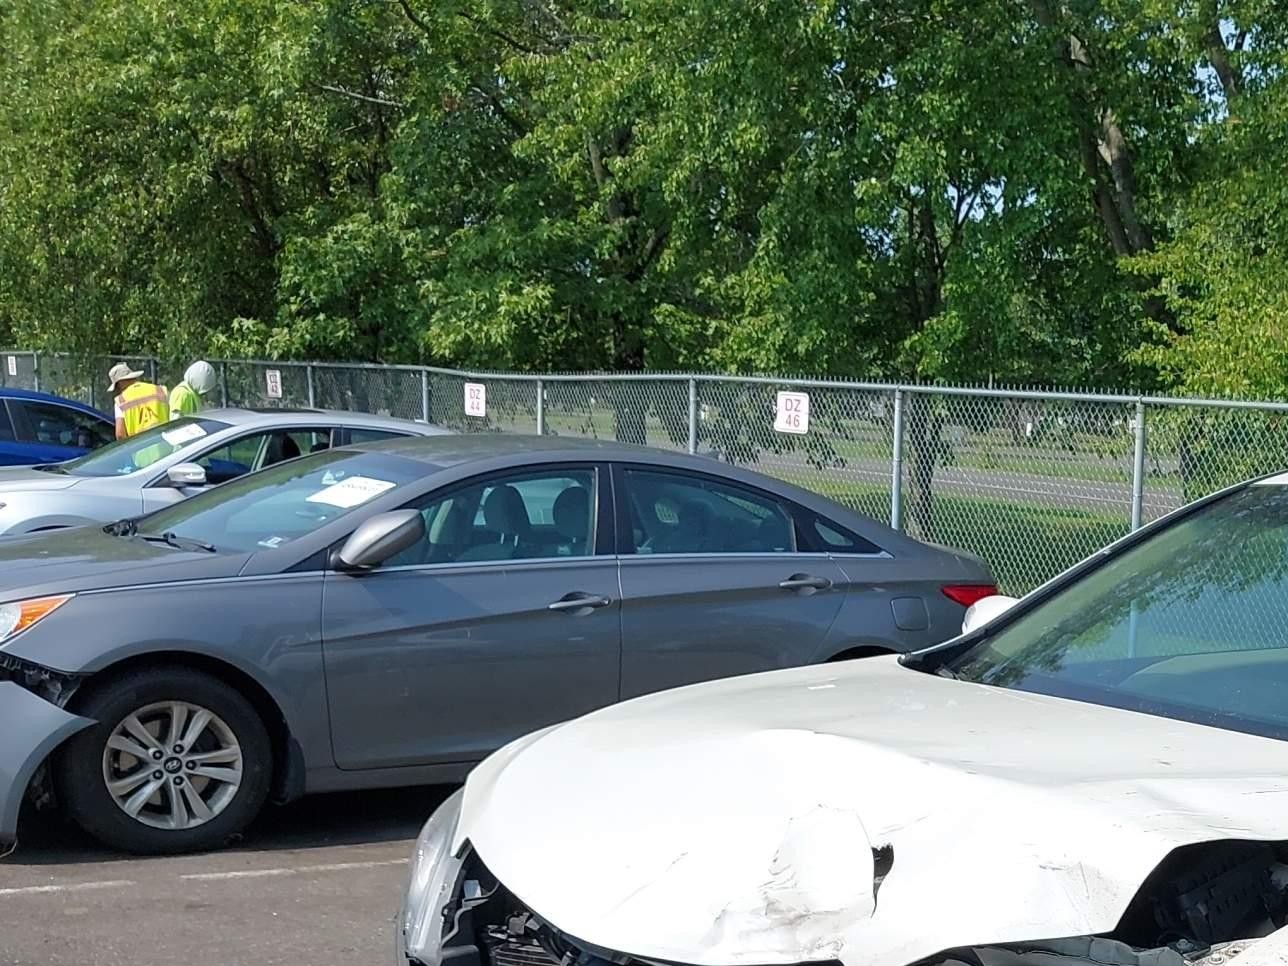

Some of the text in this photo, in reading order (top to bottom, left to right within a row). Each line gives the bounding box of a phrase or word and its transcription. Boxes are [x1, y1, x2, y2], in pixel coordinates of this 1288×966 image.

[470, 388, 481, 399] DZ
[470, 401, 480, 411] 44
[785, 398, 801, 412] DZ
[785, 414, 800, 428] 46
